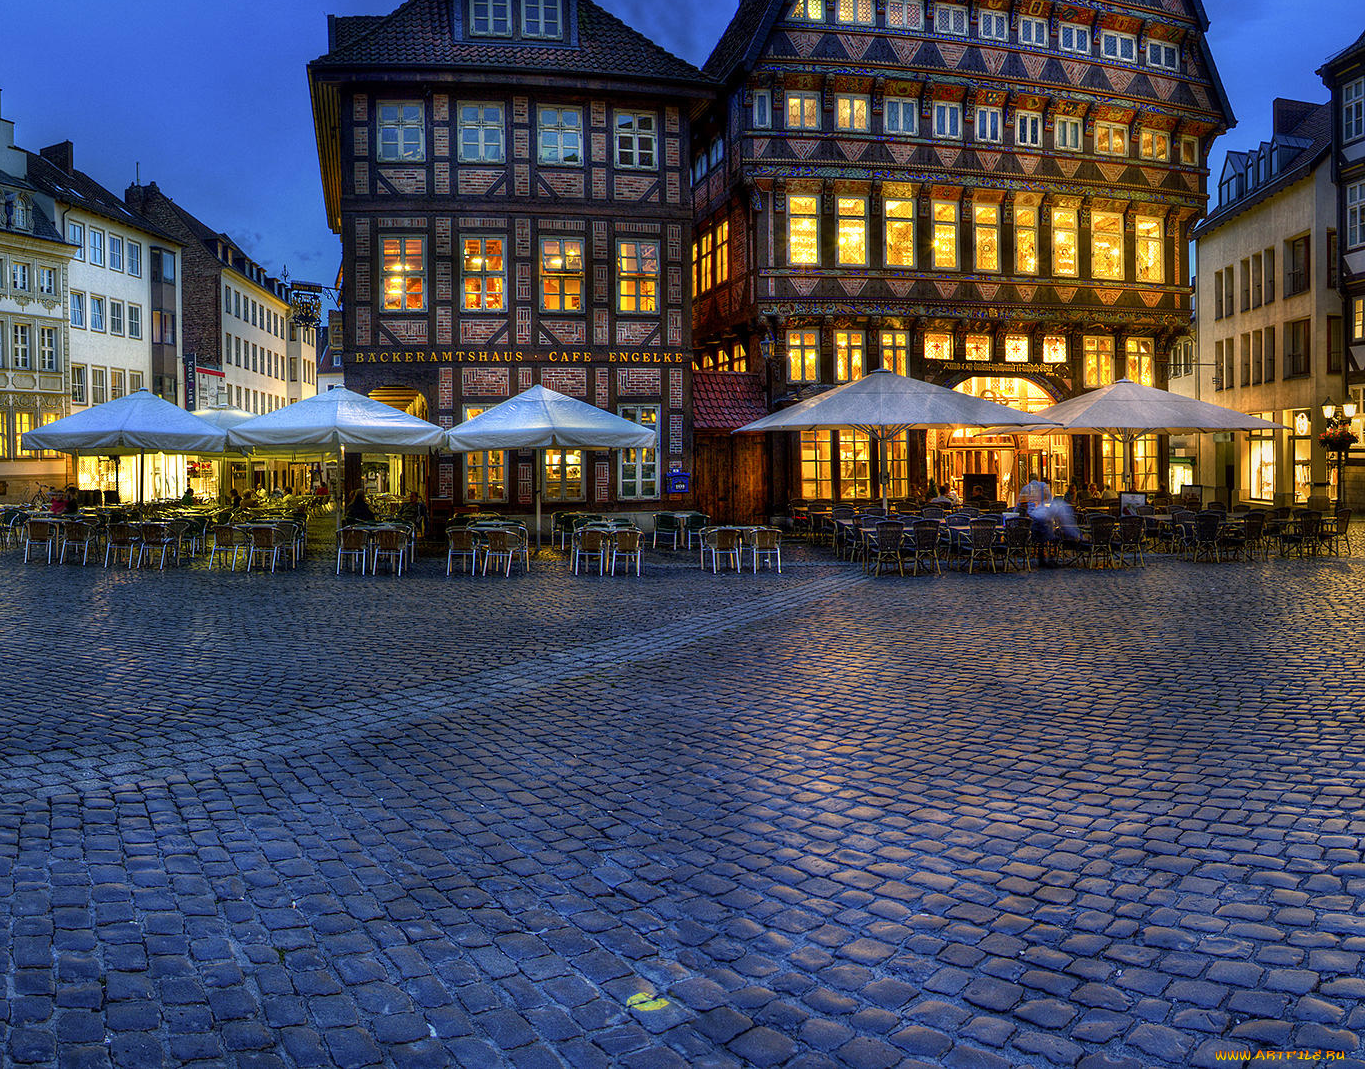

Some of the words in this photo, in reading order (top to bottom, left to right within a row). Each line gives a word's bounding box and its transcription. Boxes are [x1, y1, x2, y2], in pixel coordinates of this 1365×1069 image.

[355, 351, 523, 363] BÄCKERAMTSHAUS
[548, 351, 592, 362] CAFE
[609, 352, 683, 362] ENGELKE
